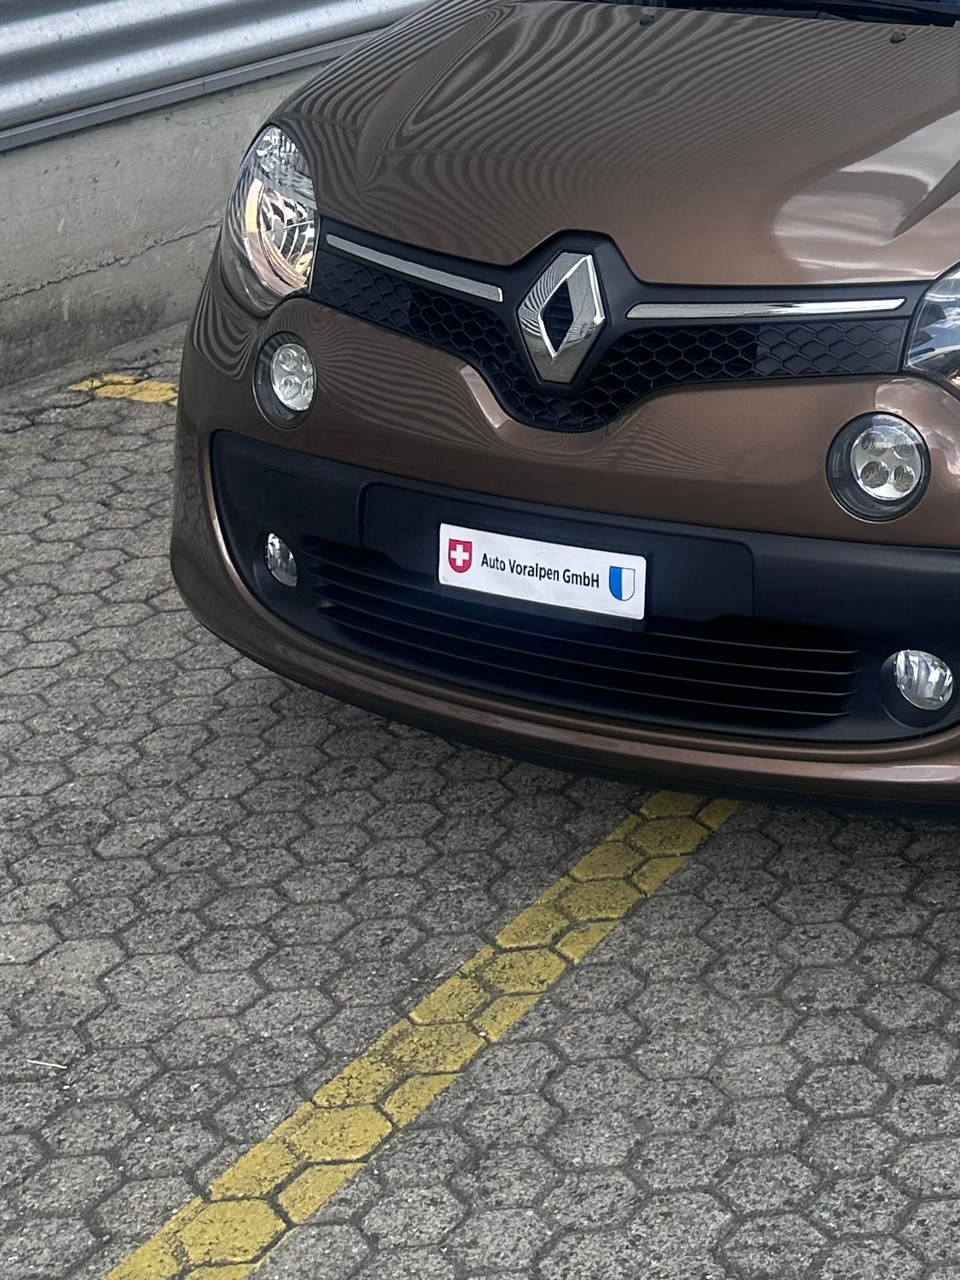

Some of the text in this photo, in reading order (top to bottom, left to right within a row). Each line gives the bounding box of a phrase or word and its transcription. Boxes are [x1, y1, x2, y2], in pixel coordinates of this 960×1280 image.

[481, 553, 600, 588] Auto Voralpen GmbH
